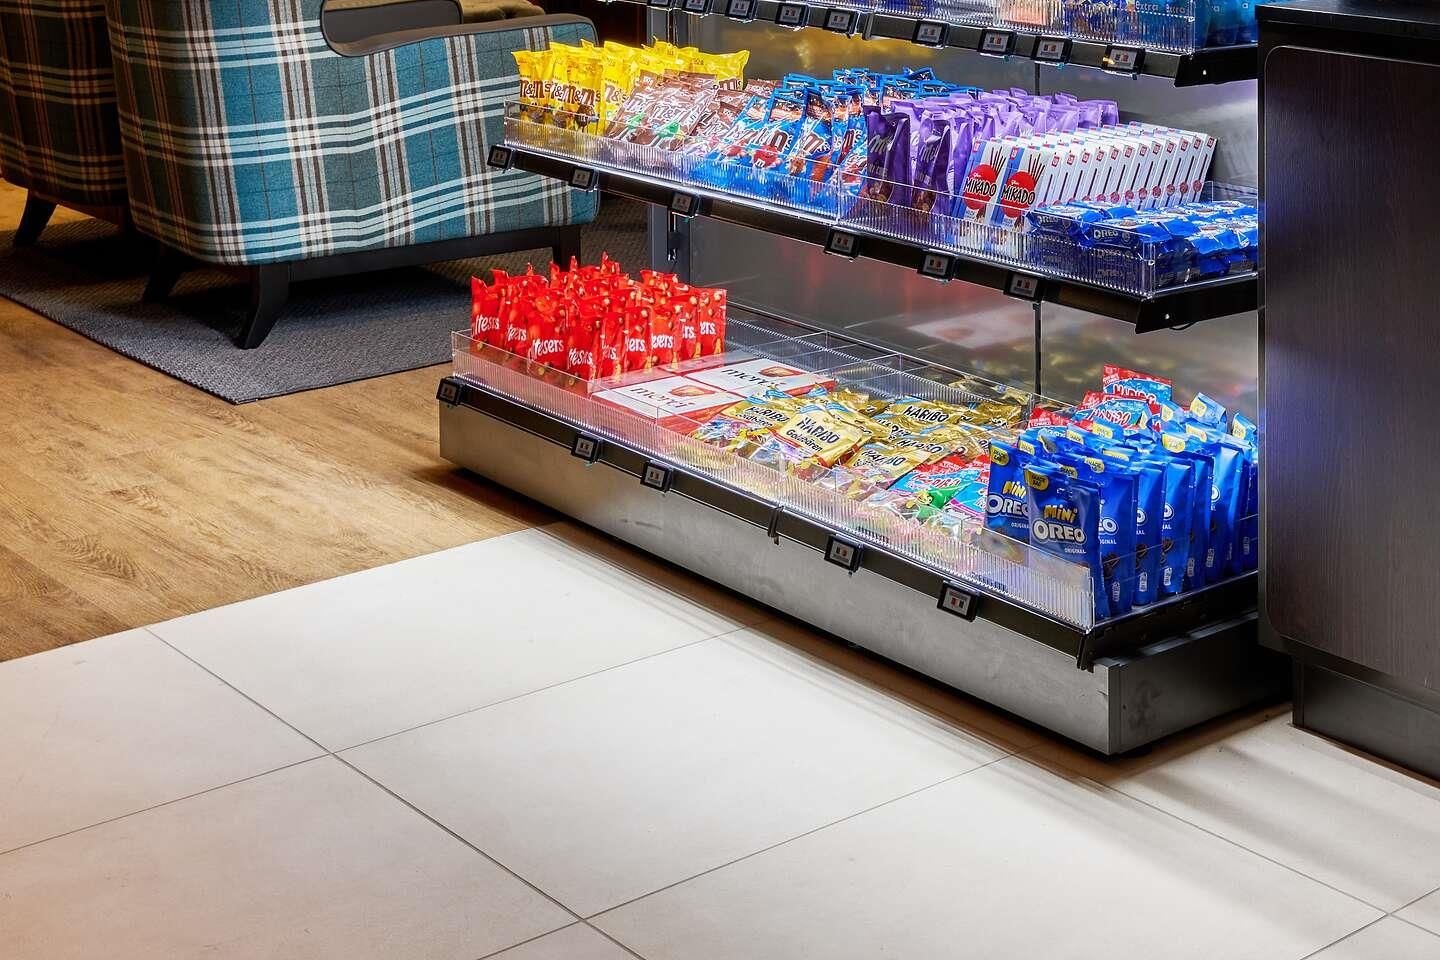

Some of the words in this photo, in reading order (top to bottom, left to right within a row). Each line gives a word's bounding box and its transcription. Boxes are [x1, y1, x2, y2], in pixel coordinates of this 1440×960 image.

[963, 176, 998, 197] MIKADO
[1001, 183, 1036, 205] MIKADO
[902, 405, 950, 423] HARIBO
[1033, 520, 1086, 544] OREO
